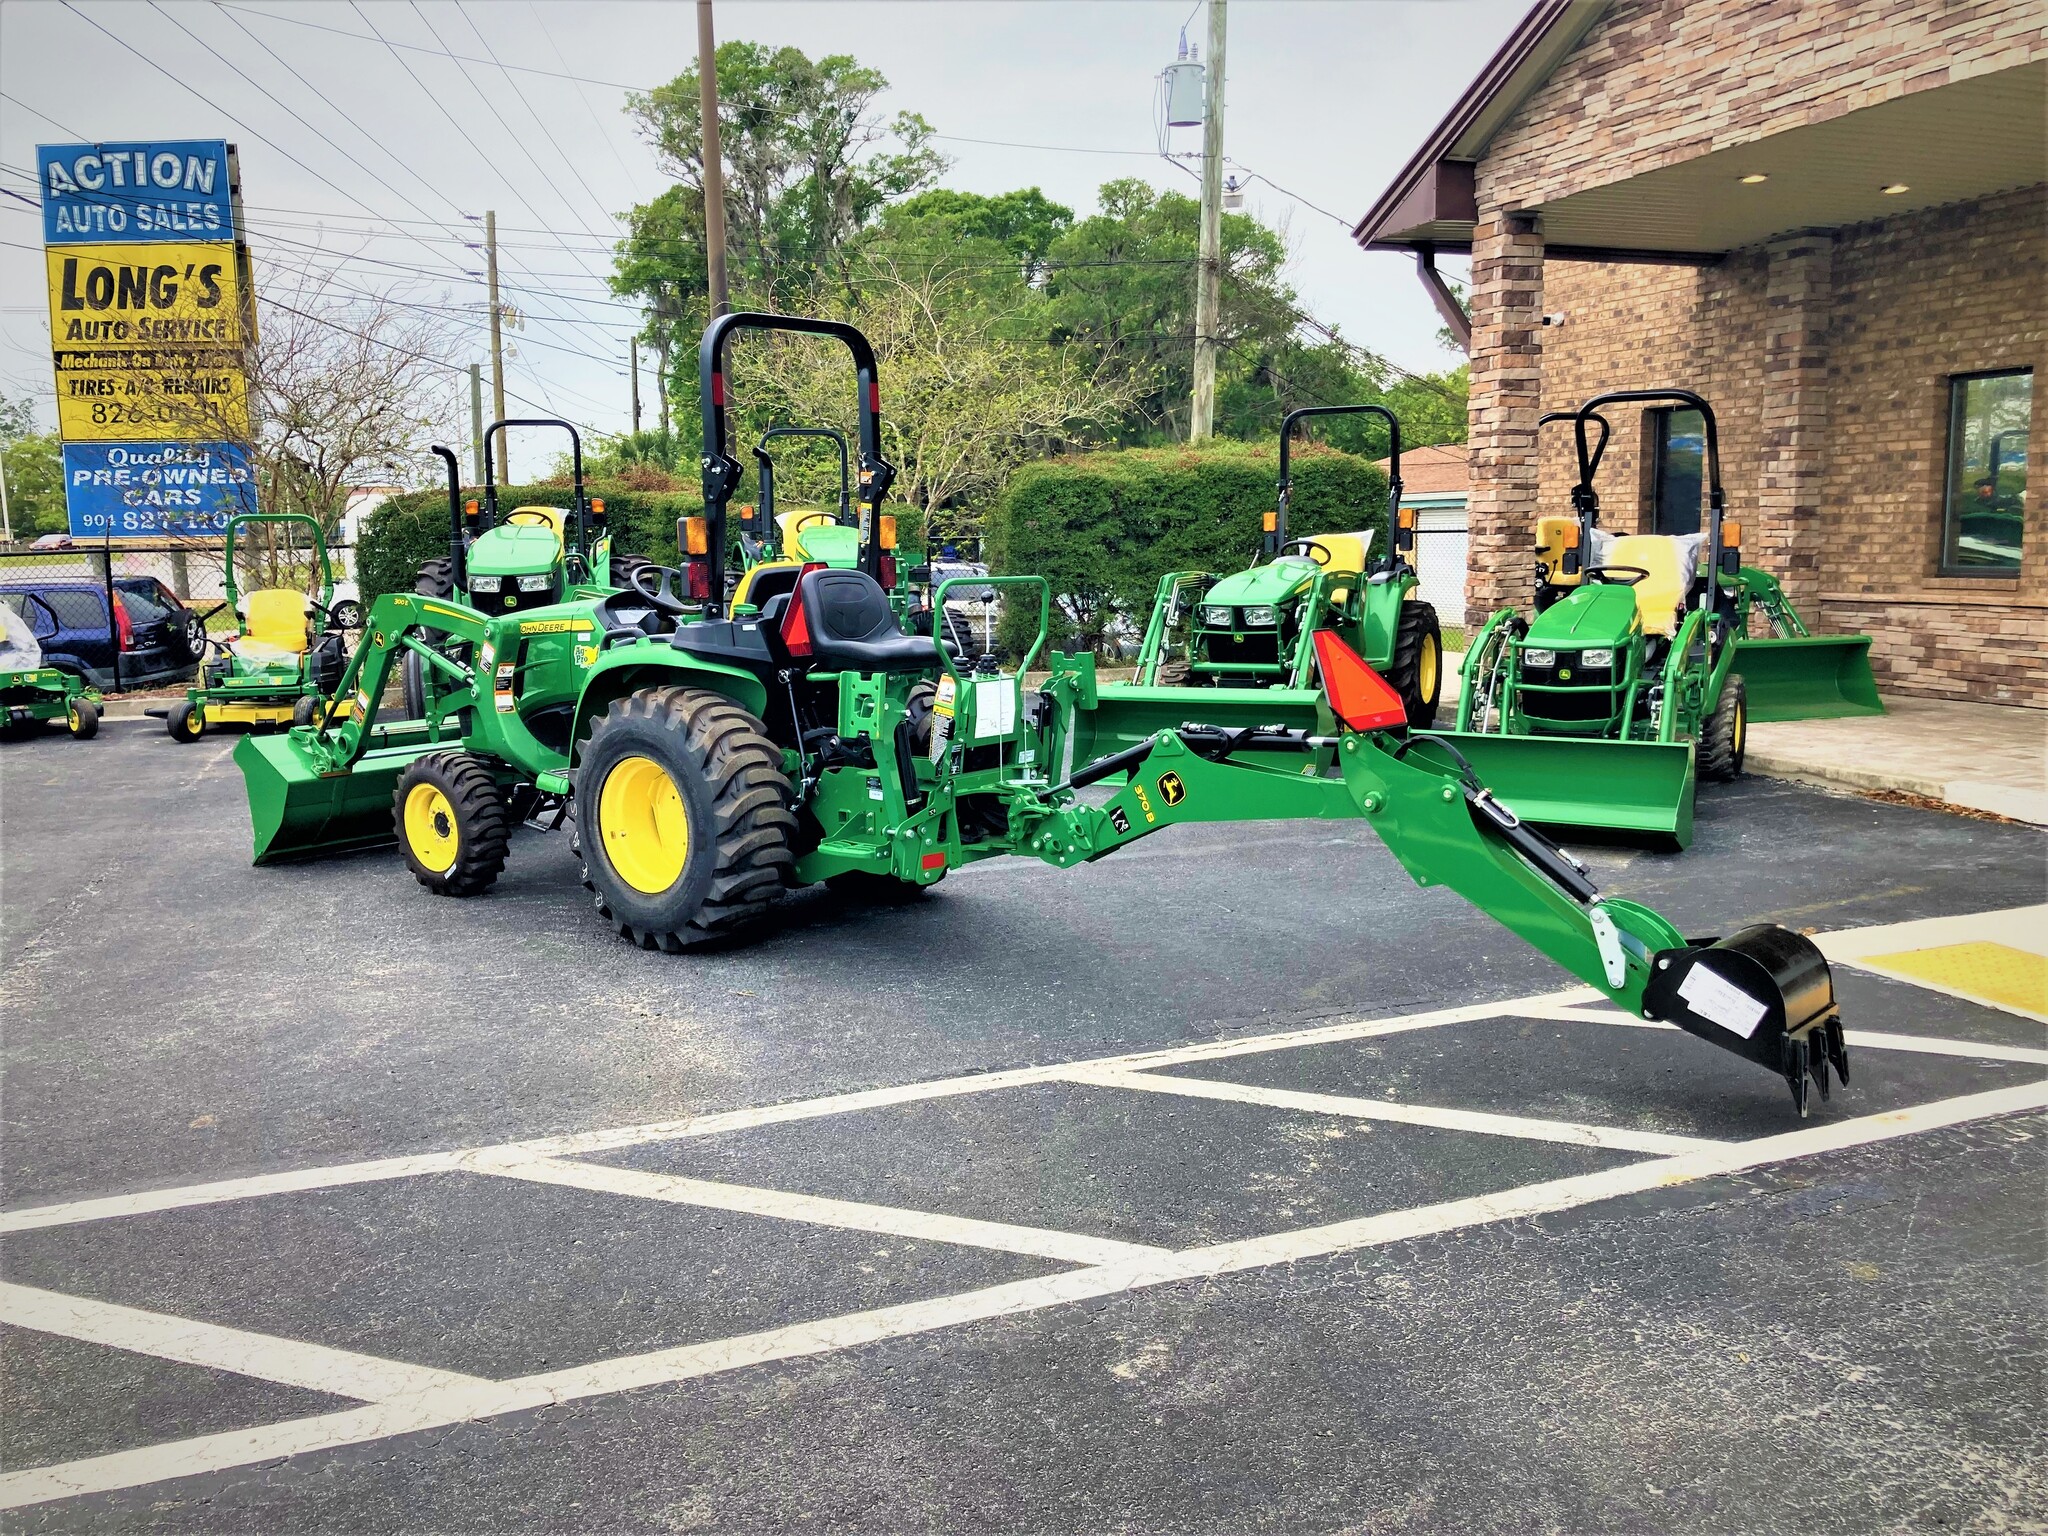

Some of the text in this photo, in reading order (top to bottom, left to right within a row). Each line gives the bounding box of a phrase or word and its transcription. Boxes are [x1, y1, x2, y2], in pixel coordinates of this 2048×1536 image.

[48, 151, 218, 199] ACTION
[56, 202, 221, 233] AUTO SALES
[61, 258, 222, 310] LONG'S
[66, 317, 227, 341] AUTO SERVICE
[132, 353, 151, 368] On
[69, 379, 116, 396] TIRES
[162, 377, 231, 395] REPAIRS
[107, 447, 211, 468] Quality
[73, 468, 249, 486] PRE-OWNED
[123, 489, 202, 505] CARS
[83, 514, 117, 527] 904
[520, 623, 565, 633] OHN DEERE
